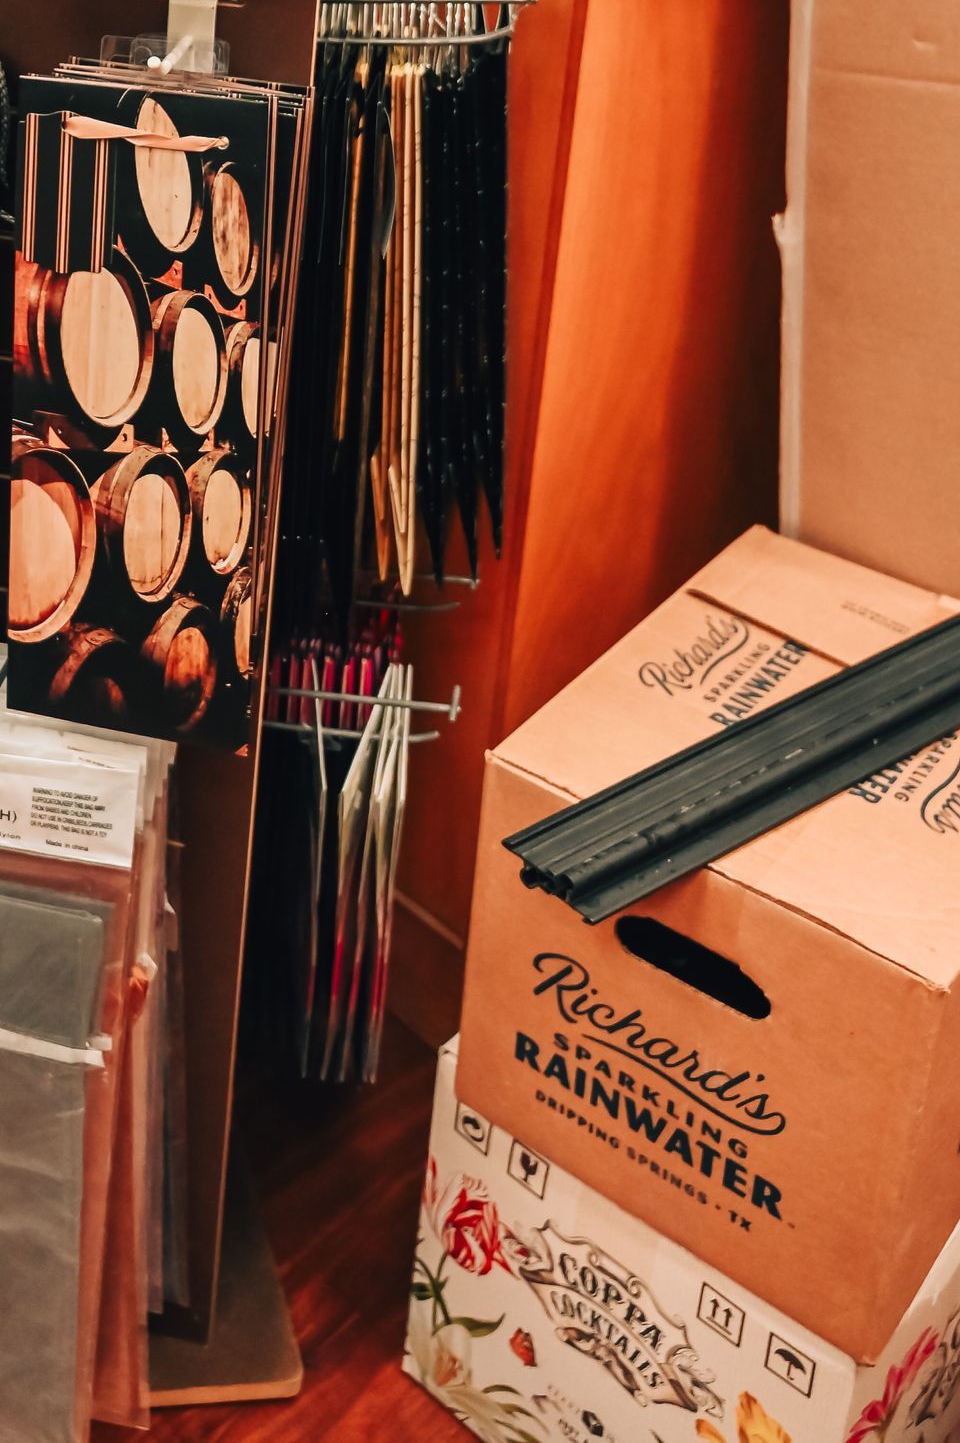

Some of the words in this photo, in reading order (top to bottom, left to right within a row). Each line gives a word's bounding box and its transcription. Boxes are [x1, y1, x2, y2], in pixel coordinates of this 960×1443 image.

[638, 613, 749, 697] Richard's
[704, 642, 771, 703] SPARKLING
[709, 639, 810, 728] RAINWATER
[45, 839, 62, 847] Made
[532, 952, 786, 1135] Richard's
[514, 1031, 783, 1221] RAINWATER
[553, 1032, 748, 1159] SPARKLING
[535, 1089, 619, 1149] DRIPPING
[626, 1146, 708, 1205] SPRINGS
[728, 1209, 752, 1232] TX
[550, 1290, 664, 1388] COCKTAILS
[559, 1252, 666, 1354] COPPA
